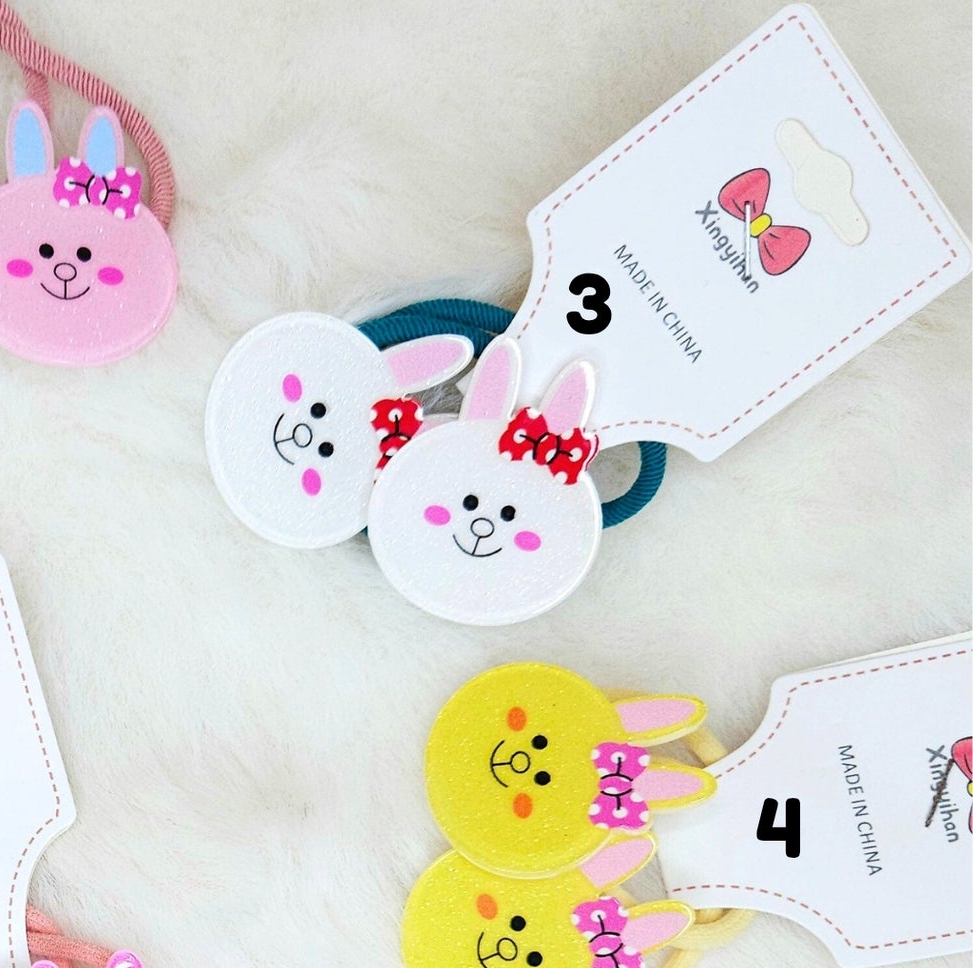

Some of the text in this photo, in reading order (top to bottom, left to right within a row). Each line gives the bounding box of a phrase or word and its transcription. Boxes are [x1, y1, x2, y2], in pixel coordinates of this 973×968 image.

[613, 244, 702, 363] MADE IN CHINA
[694, 200, 760, 294] Xingyihn
[838, 745, 882, 876] MADE IN CHINA
